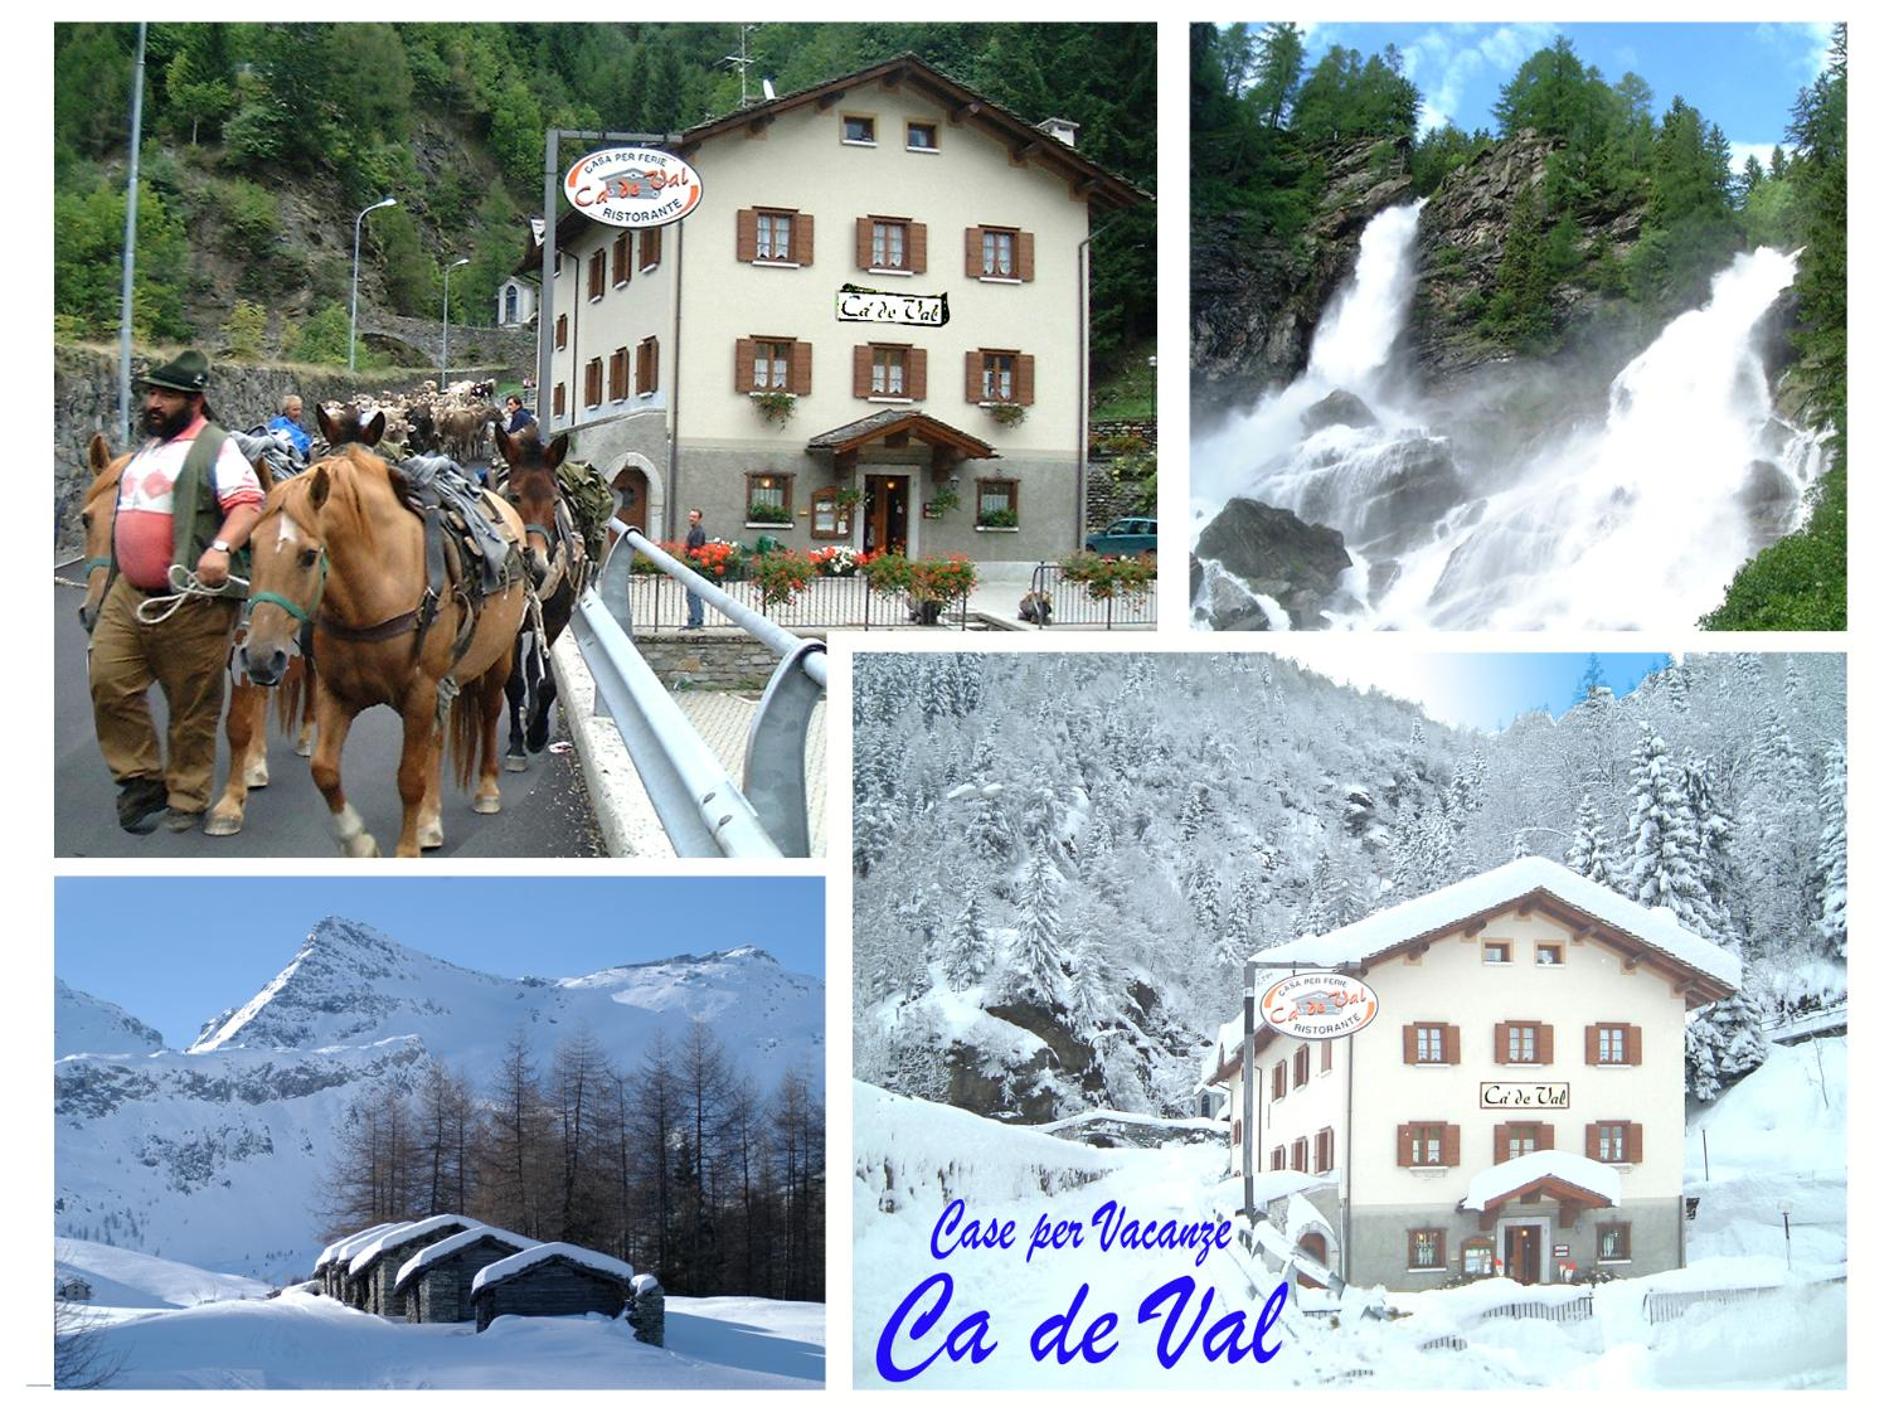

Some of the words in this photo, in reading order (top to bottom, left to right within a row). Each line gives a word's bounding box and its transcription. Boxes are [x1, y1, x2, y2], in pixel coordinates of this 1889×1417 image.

[584, 157, 612, 174] CASA
[614, 152, 635, 163] PER
[638, 154, 667, 167] FERIE
[618, 181, 641, 198] de
[644, 168, 689, 190] Val
[602, 199, 682, 222] RISTORANTE
[878, 301, 896, 318] de
[903, 299, 938, 321] Val
[1278, 980, 1301, 997] CASA
[1323, 978, 1348, 988] FERIE
[1307, 1002, 1326, 1015] de
[1328, 987, 1367, 1008] Val
[1294, 1013, 1361, 1035] RISTORANTE
[1514, 1089, 1531, 1105] de
[1536, 1087, 1566, 1105] Val
